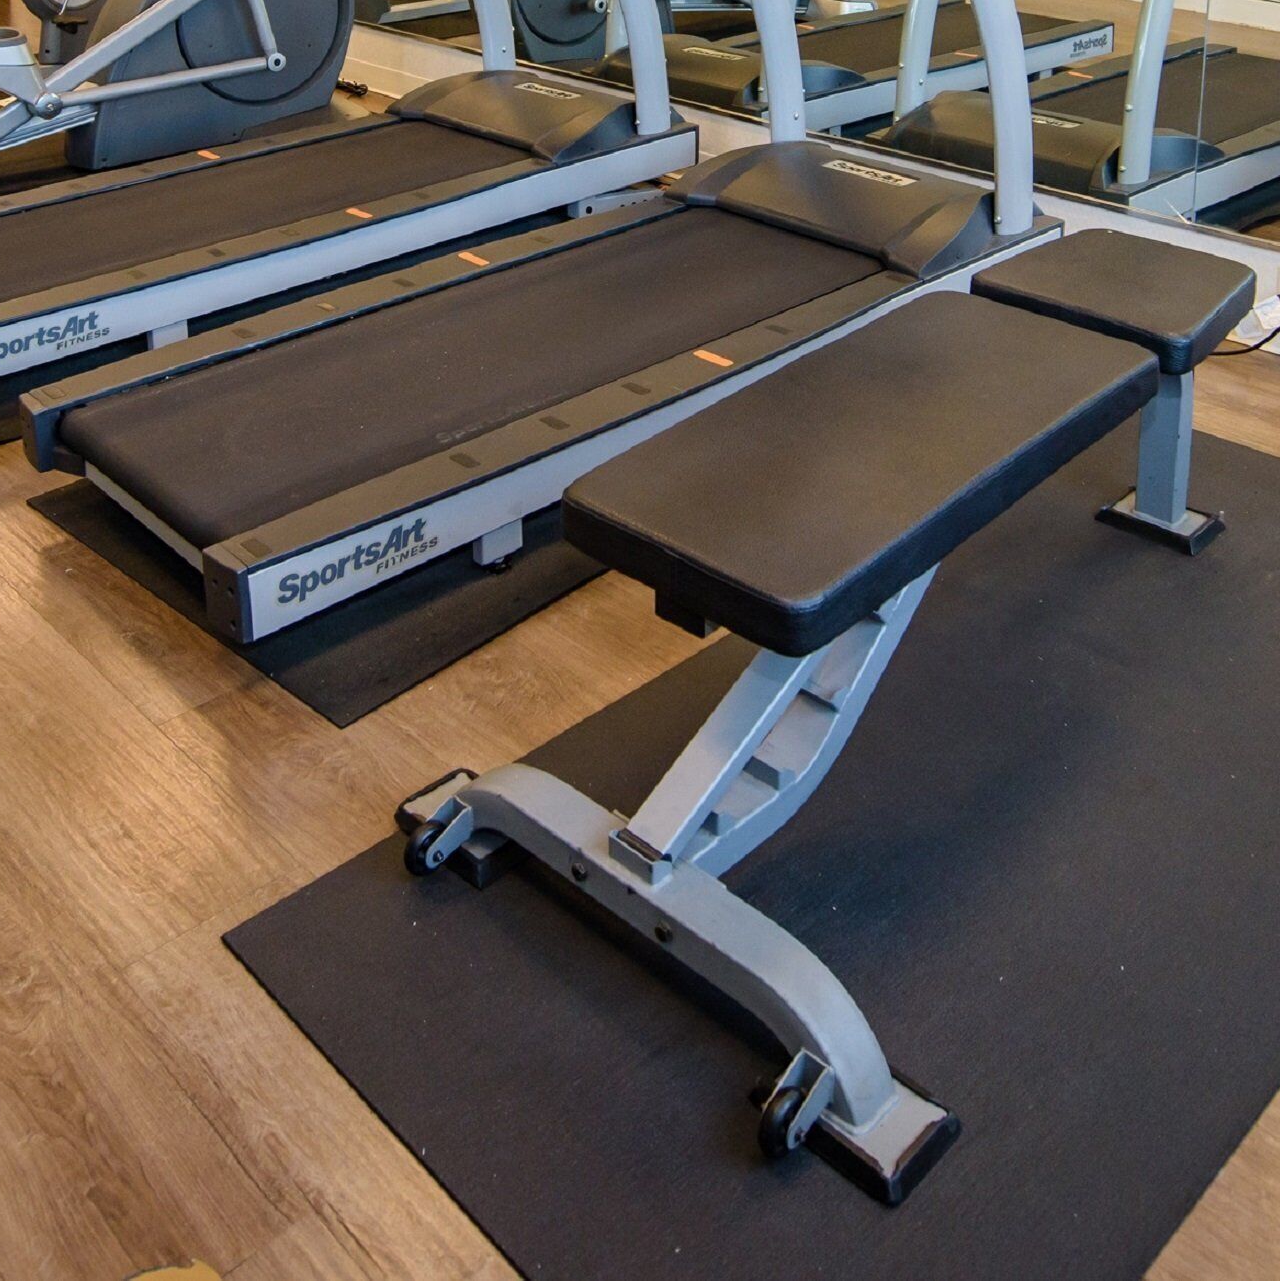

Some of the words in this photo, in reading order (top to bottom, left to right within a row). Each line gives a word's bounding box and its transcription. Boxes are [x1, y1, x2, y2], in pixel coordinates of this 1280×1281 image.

[56, 327, 110, 351] FITNESS
[277, 517, 427, 603] SportsArt
[375, 536, 438, 574] FITNESS
